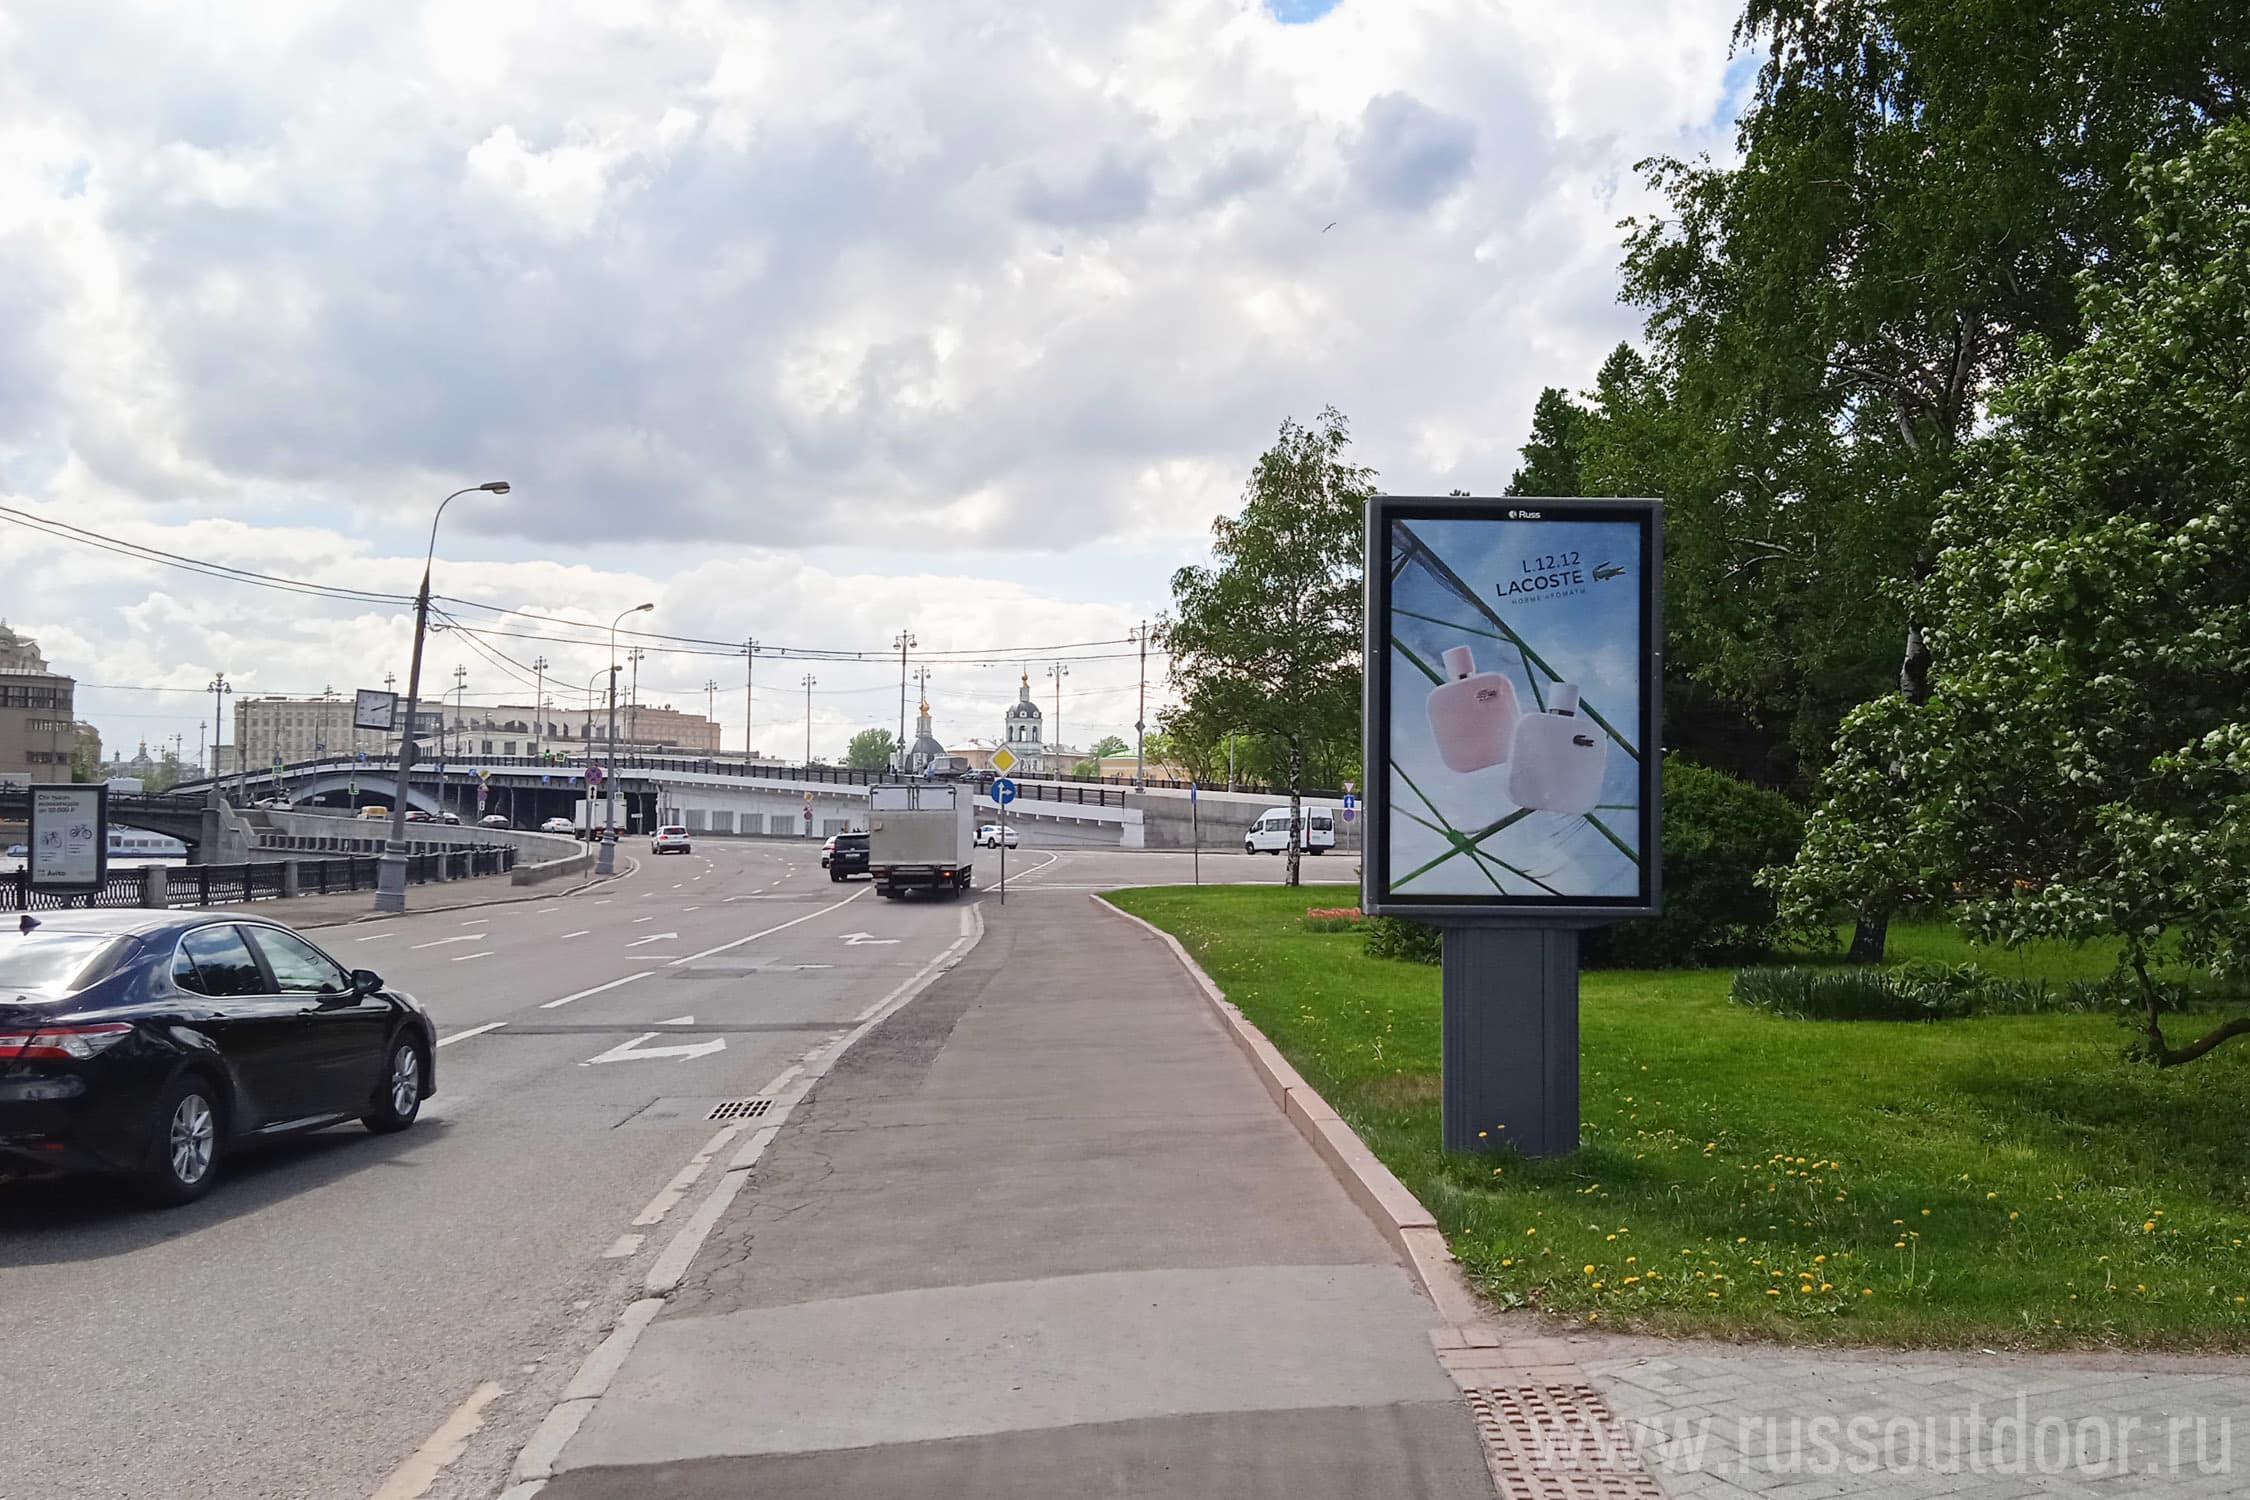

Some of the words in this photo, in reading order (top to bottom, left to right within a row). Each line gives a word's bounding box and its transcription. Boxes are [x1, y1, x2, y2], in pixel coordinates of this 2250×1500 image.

[1518, 510, 1541, 519] Russ
[1522, 551, 1581, 573] L.12.12
[1496, 570, 1585, 597] LACOSTE
